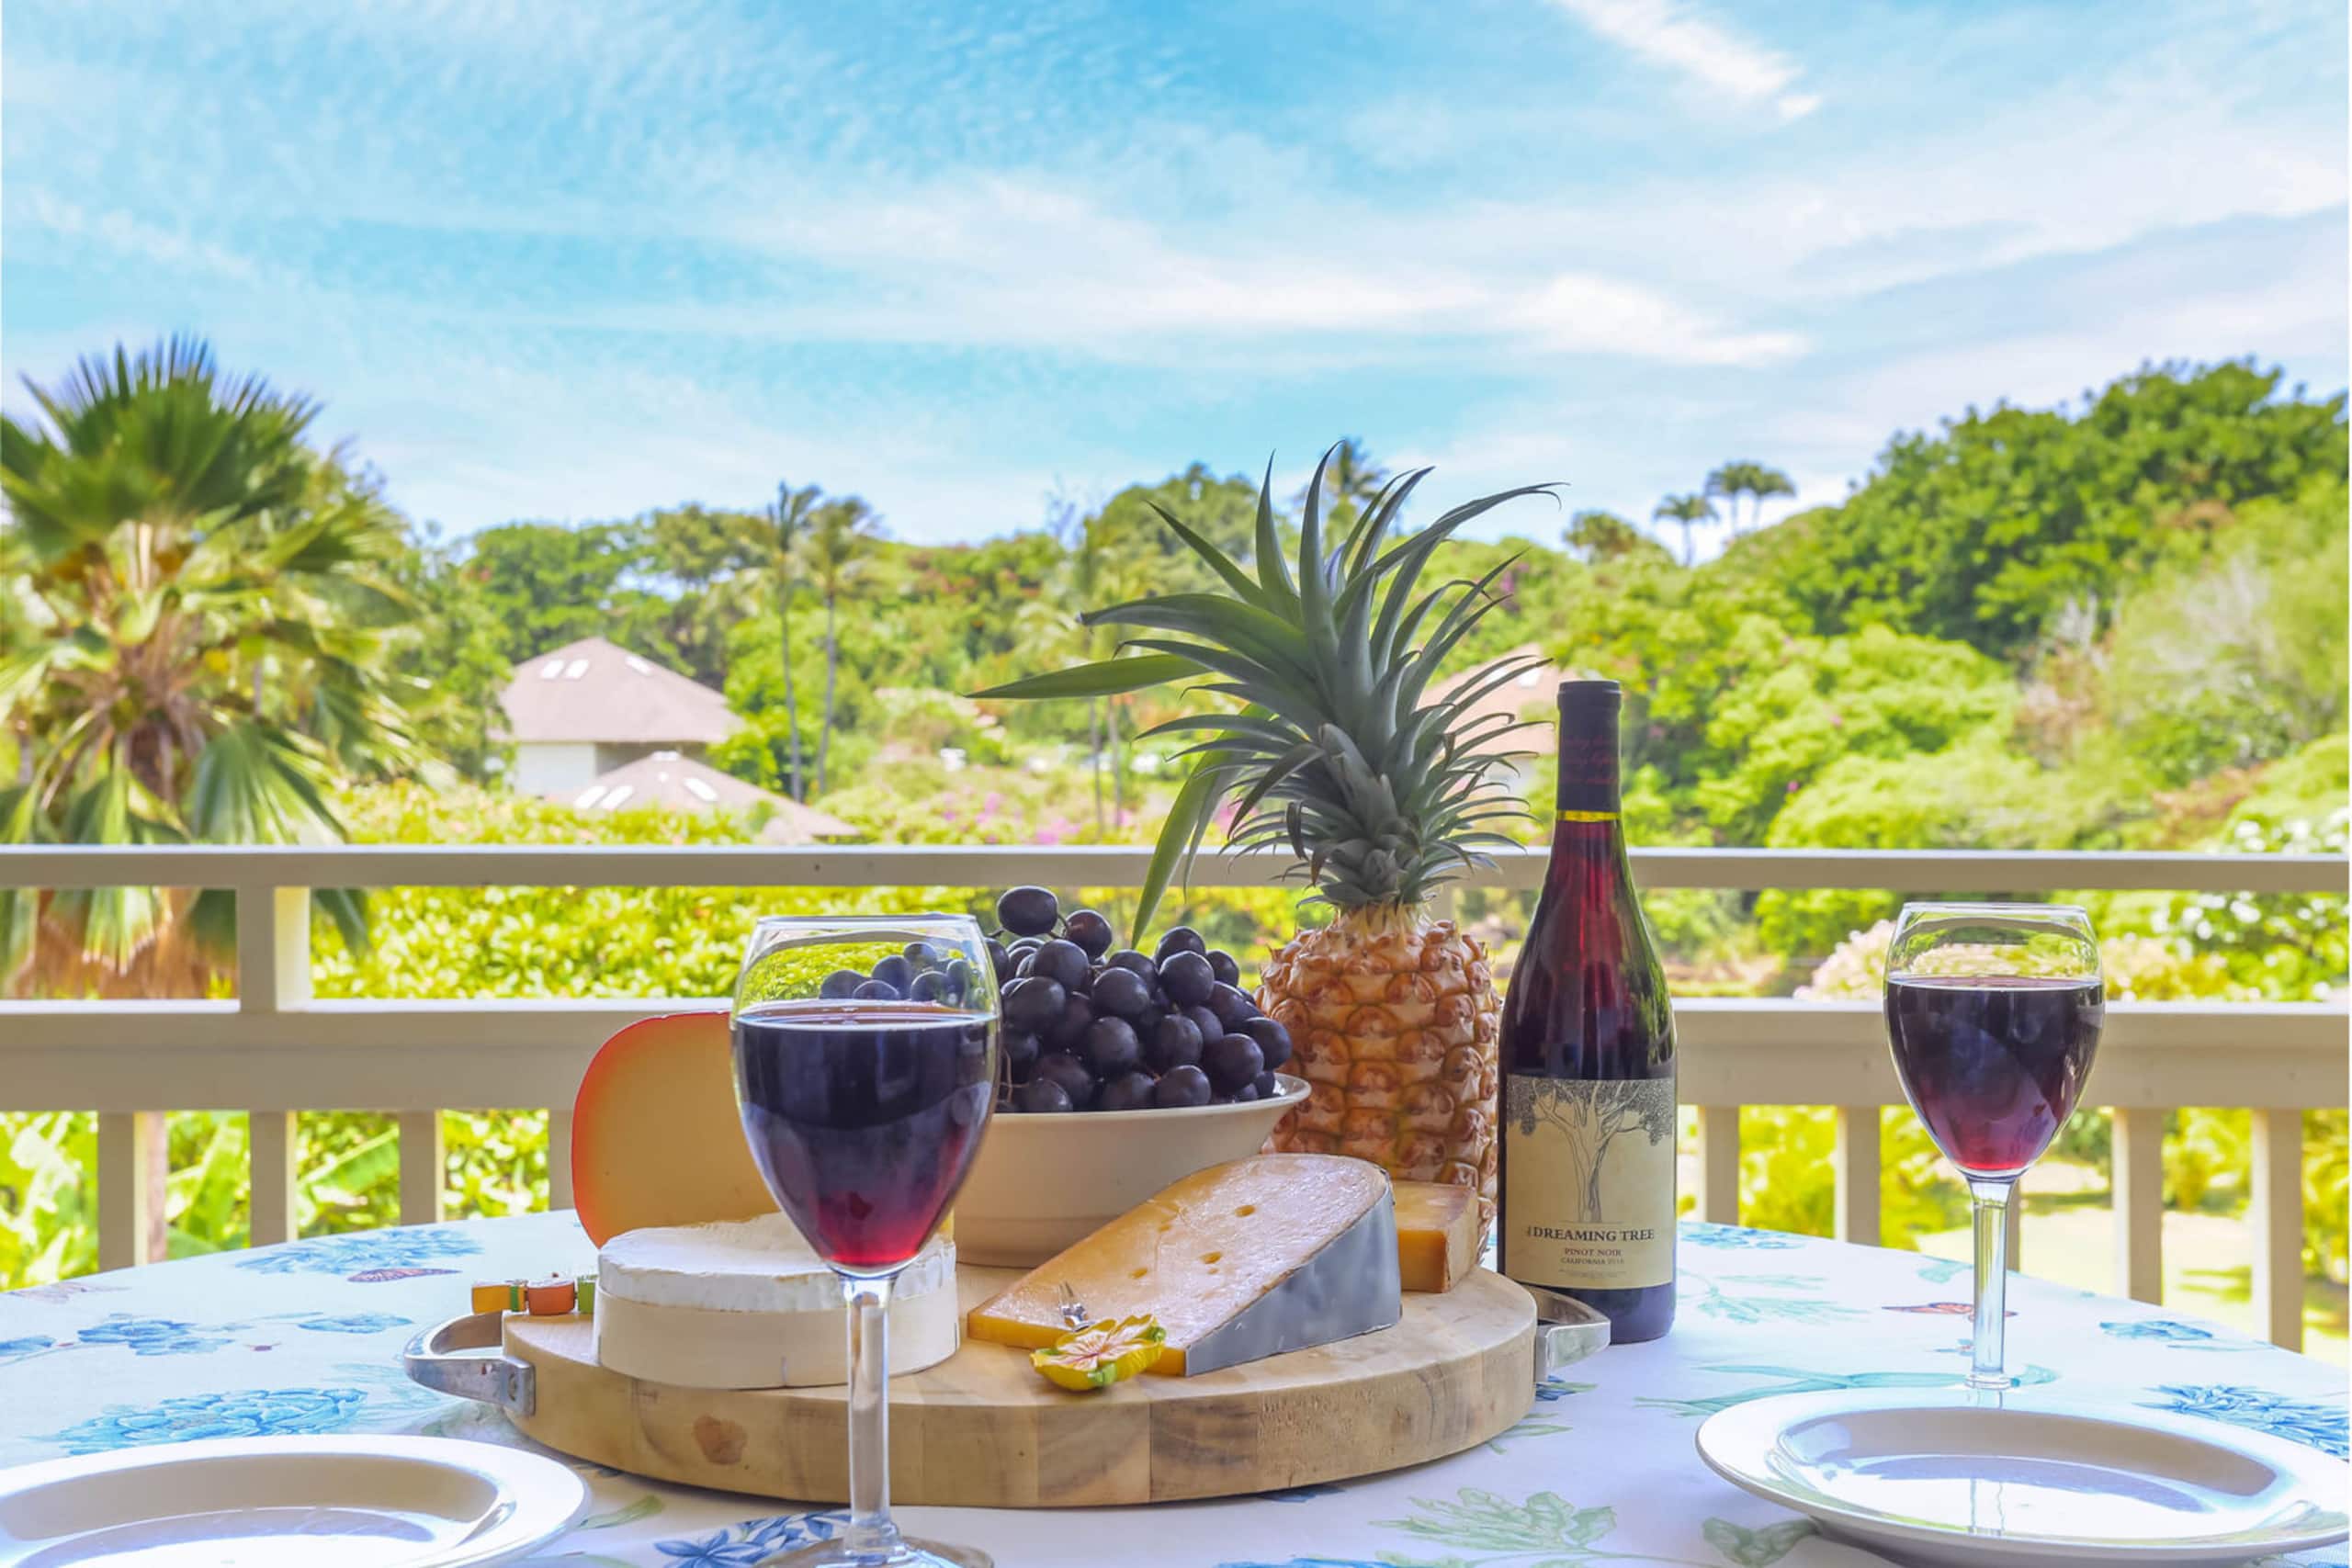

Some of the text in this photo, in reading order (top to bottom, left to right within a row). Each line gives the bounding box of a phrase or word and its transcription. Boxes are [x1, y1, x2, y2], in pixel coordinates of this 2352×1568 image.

[1533, 1226, 1617, 1241] DREAMING
[1620, 1228, 1655, 1241] TREE
[1565, 1247, 1622, 1257] PINOT NOIR
[1560, 1257, 1606, 1265] CALIFORNIA
